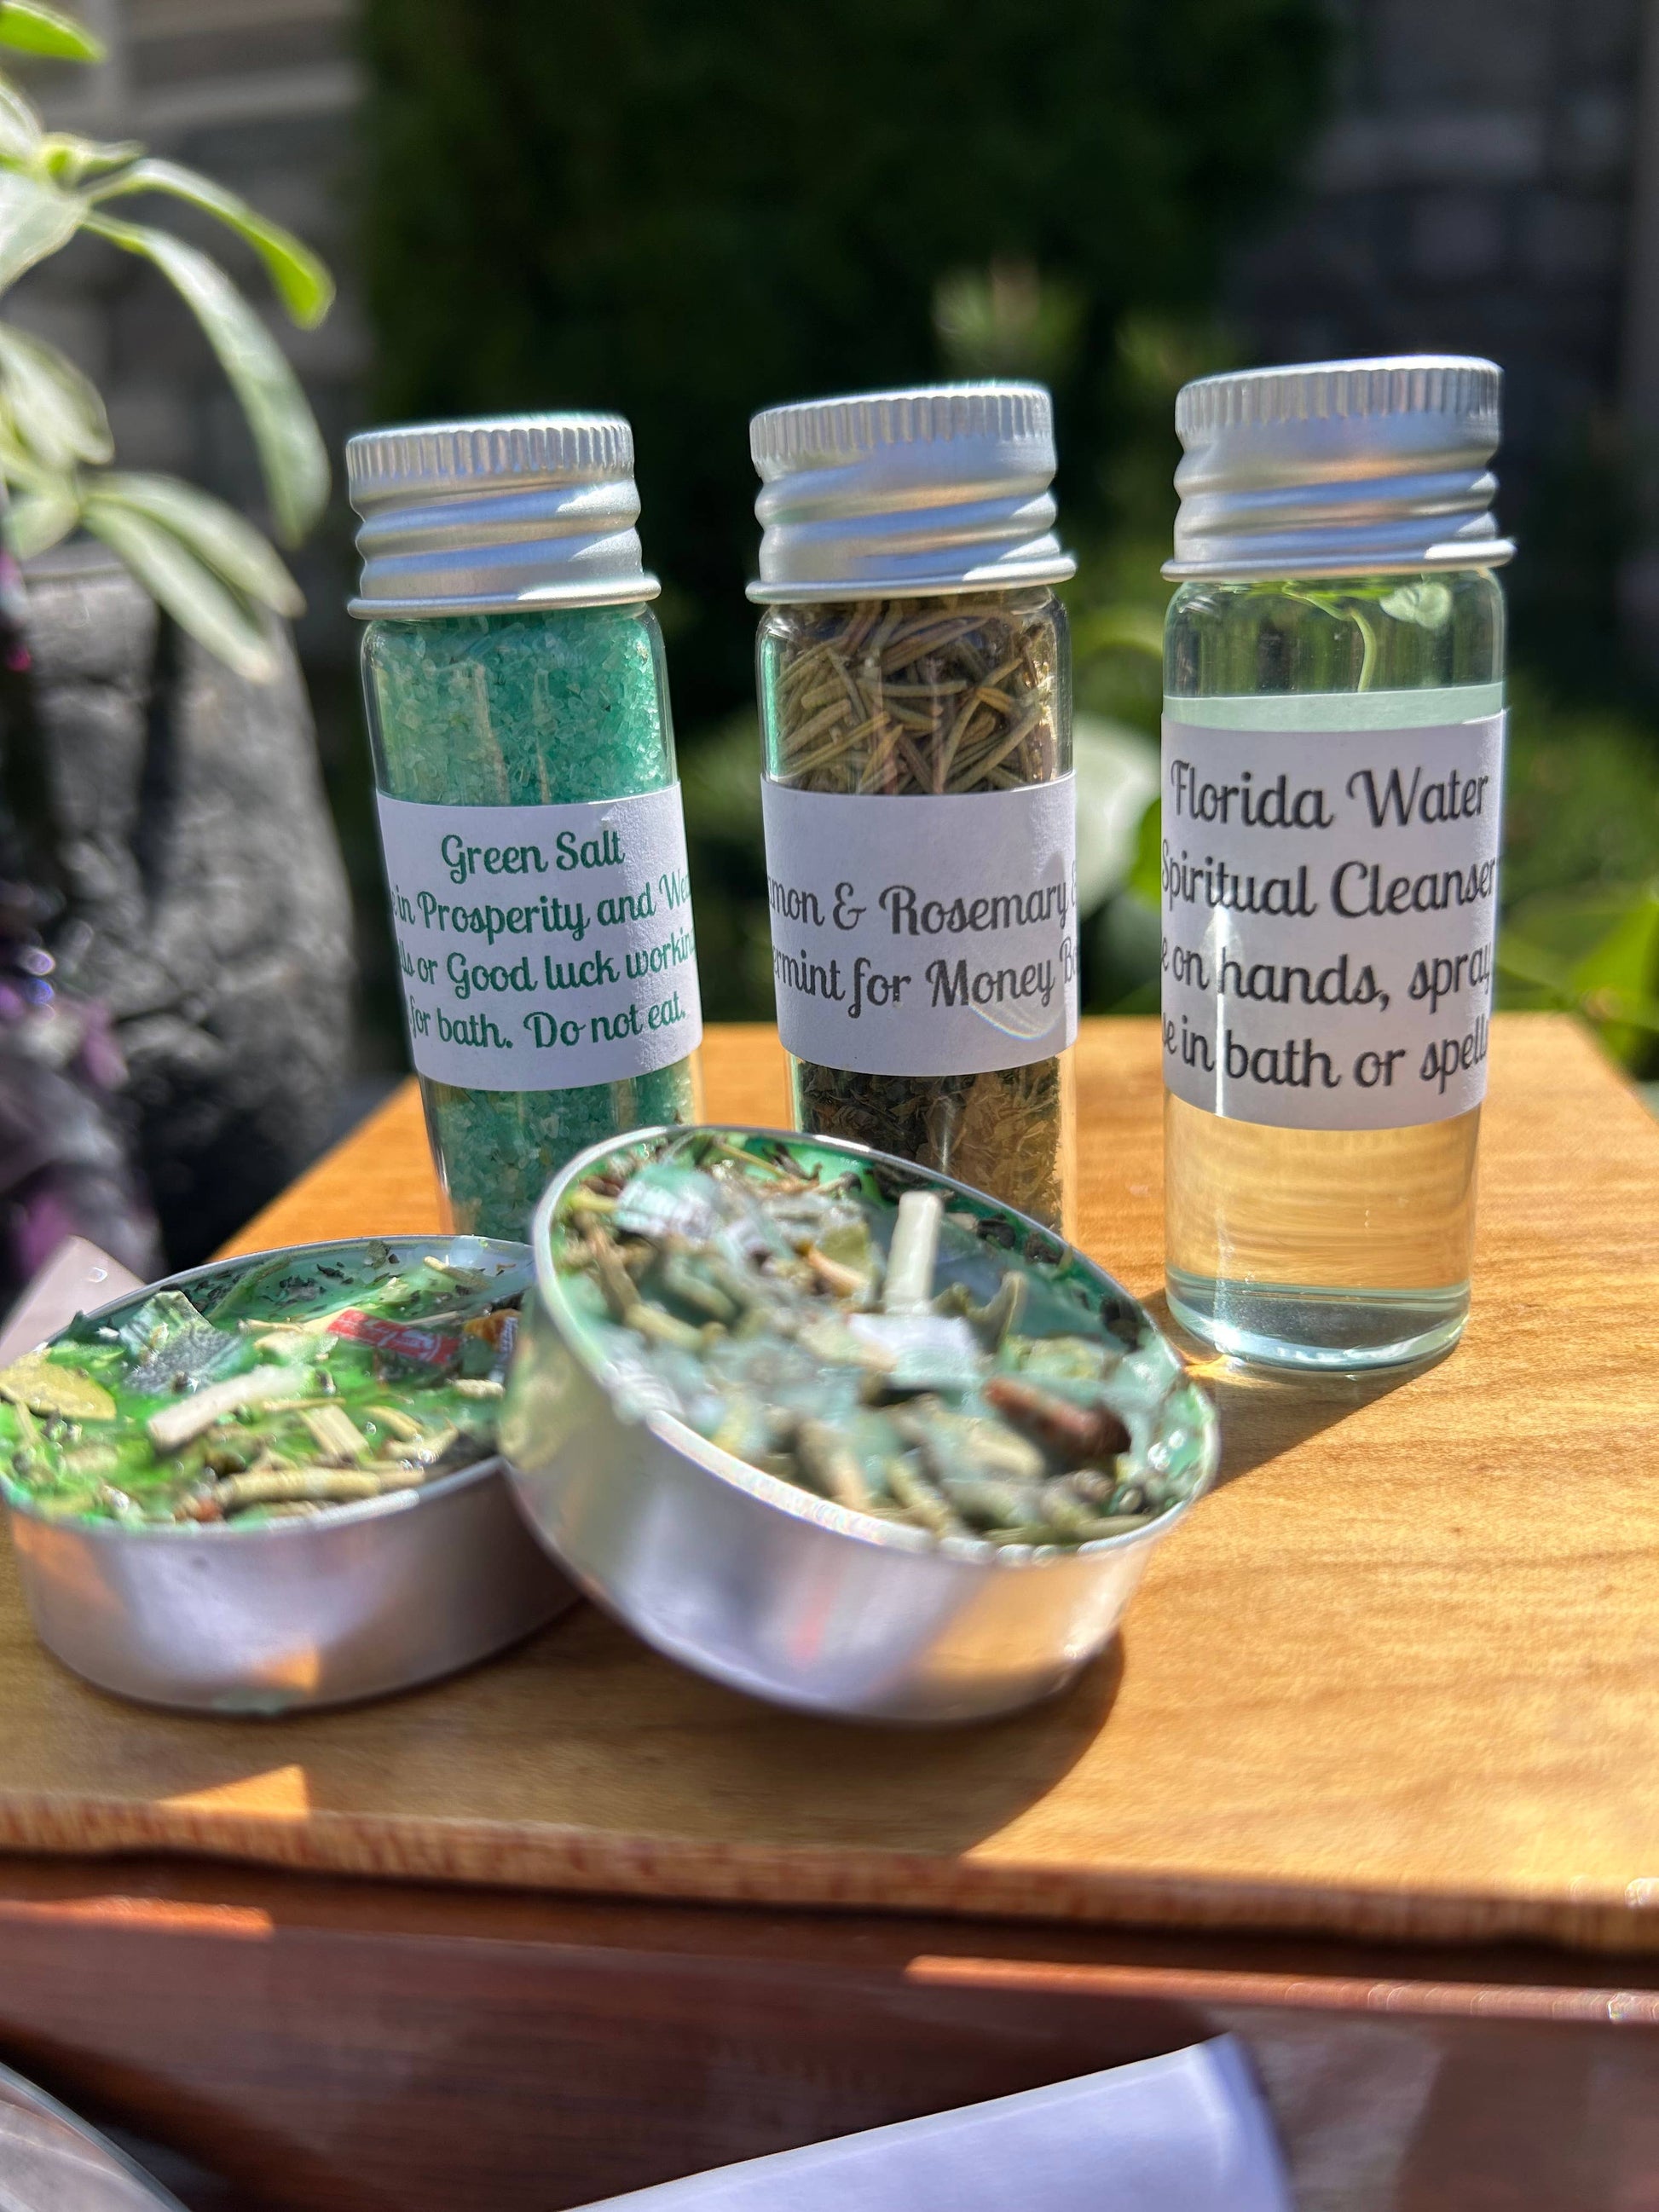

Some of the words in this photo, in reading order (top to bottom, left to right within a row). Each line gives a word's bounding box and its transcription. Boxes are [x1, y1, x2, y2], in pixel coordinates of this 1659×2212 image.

[1171, 759, 1335, 829] Florida
[1346, 765, 1489, 829] Water
[442, 835, 547, 884] Green
[556, 830, 625, 871] Salt
[1161, 838, 1317, 917] Spiritual
[1330, 855, 1495, 919] Cleanser
[417, 891, 591, 946] Prosperity
[597, 881, 657, 927] and
[832, 881, 866, 931] &
[878, 880, 1069, 936] Rosemary
[418, 956, 438, 985] or
[447, 951, 537, 1000] Good
[544, 950, 621, 991] luck
[847, 956, 911, 1019] for
[924, 958, 1055, 1008] Money
[1173, 943, 1209, 991] on
[1217, 946, 1390, 1012] hands,
[436, 1008, 513, 1049] bath.
[523, 1011, 585, 1048] Do
[591, 1003, 644, 1043] not
[648, 990, 686, 1031] eat.
[1182, 1014, 1215, 1073] in
[1225, 1029, 1341, 1089] bath
[1353, 1048, 1406, 1089] or
